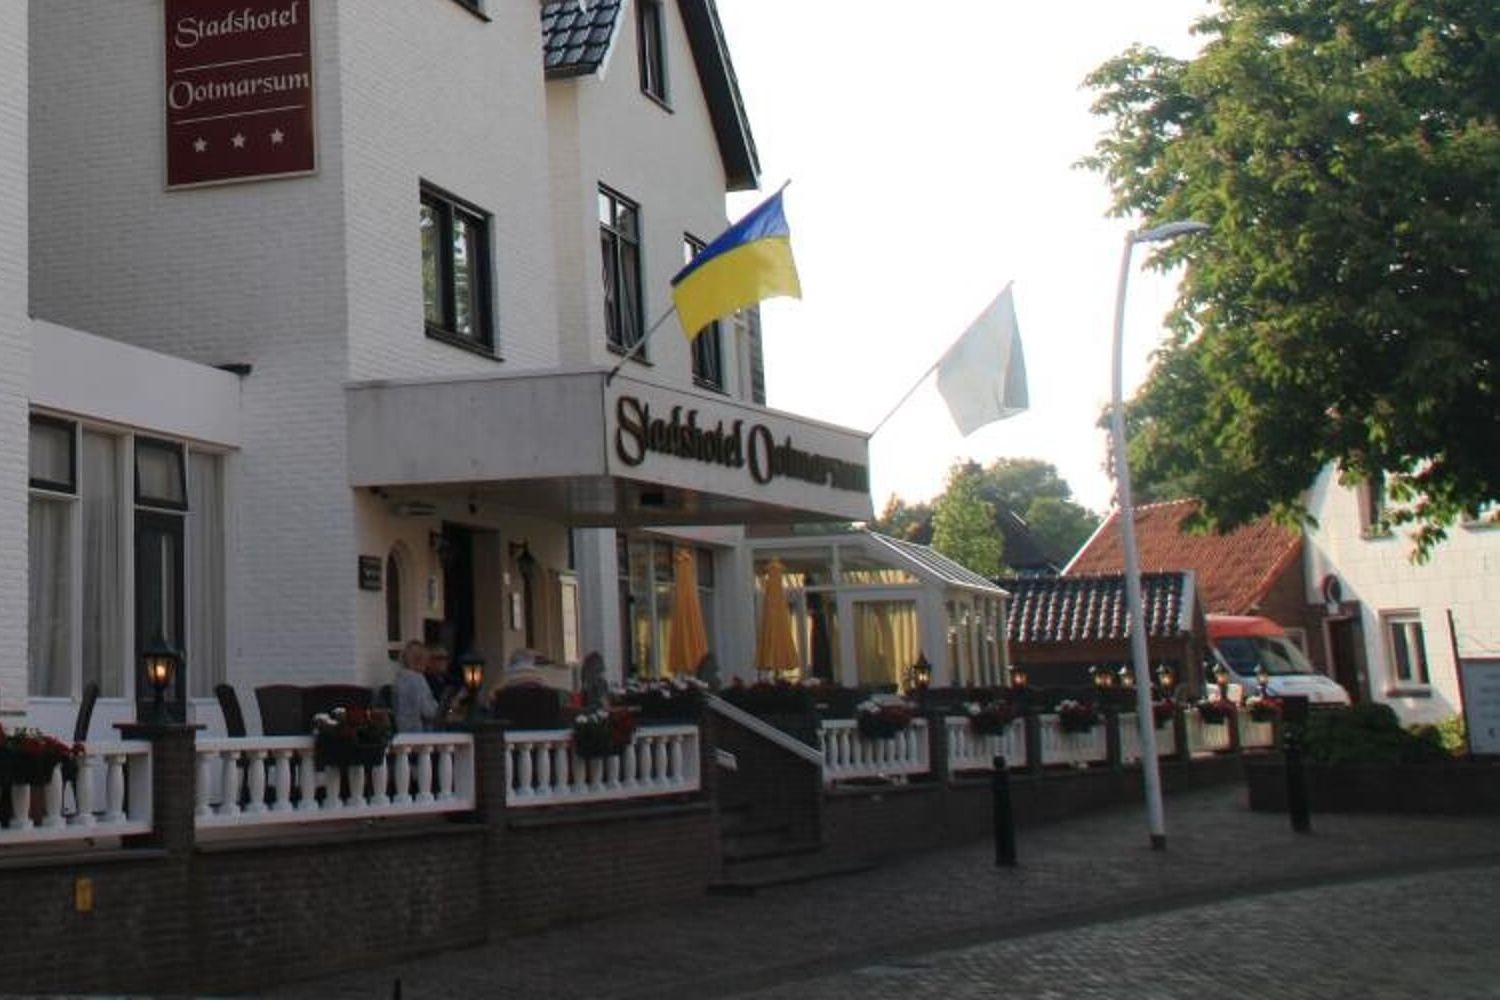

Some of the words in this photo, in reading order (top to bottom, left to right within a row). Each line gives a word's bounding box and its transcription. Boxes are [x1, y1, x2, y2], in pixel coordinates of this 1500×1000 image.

[175, 1, 298, 48] Stadshotel
[169, 72, 309, 109] Ootmarsum
[616, 396, 744, 467] Stadshotel
[748, 423, 869, 494] Ootmar
